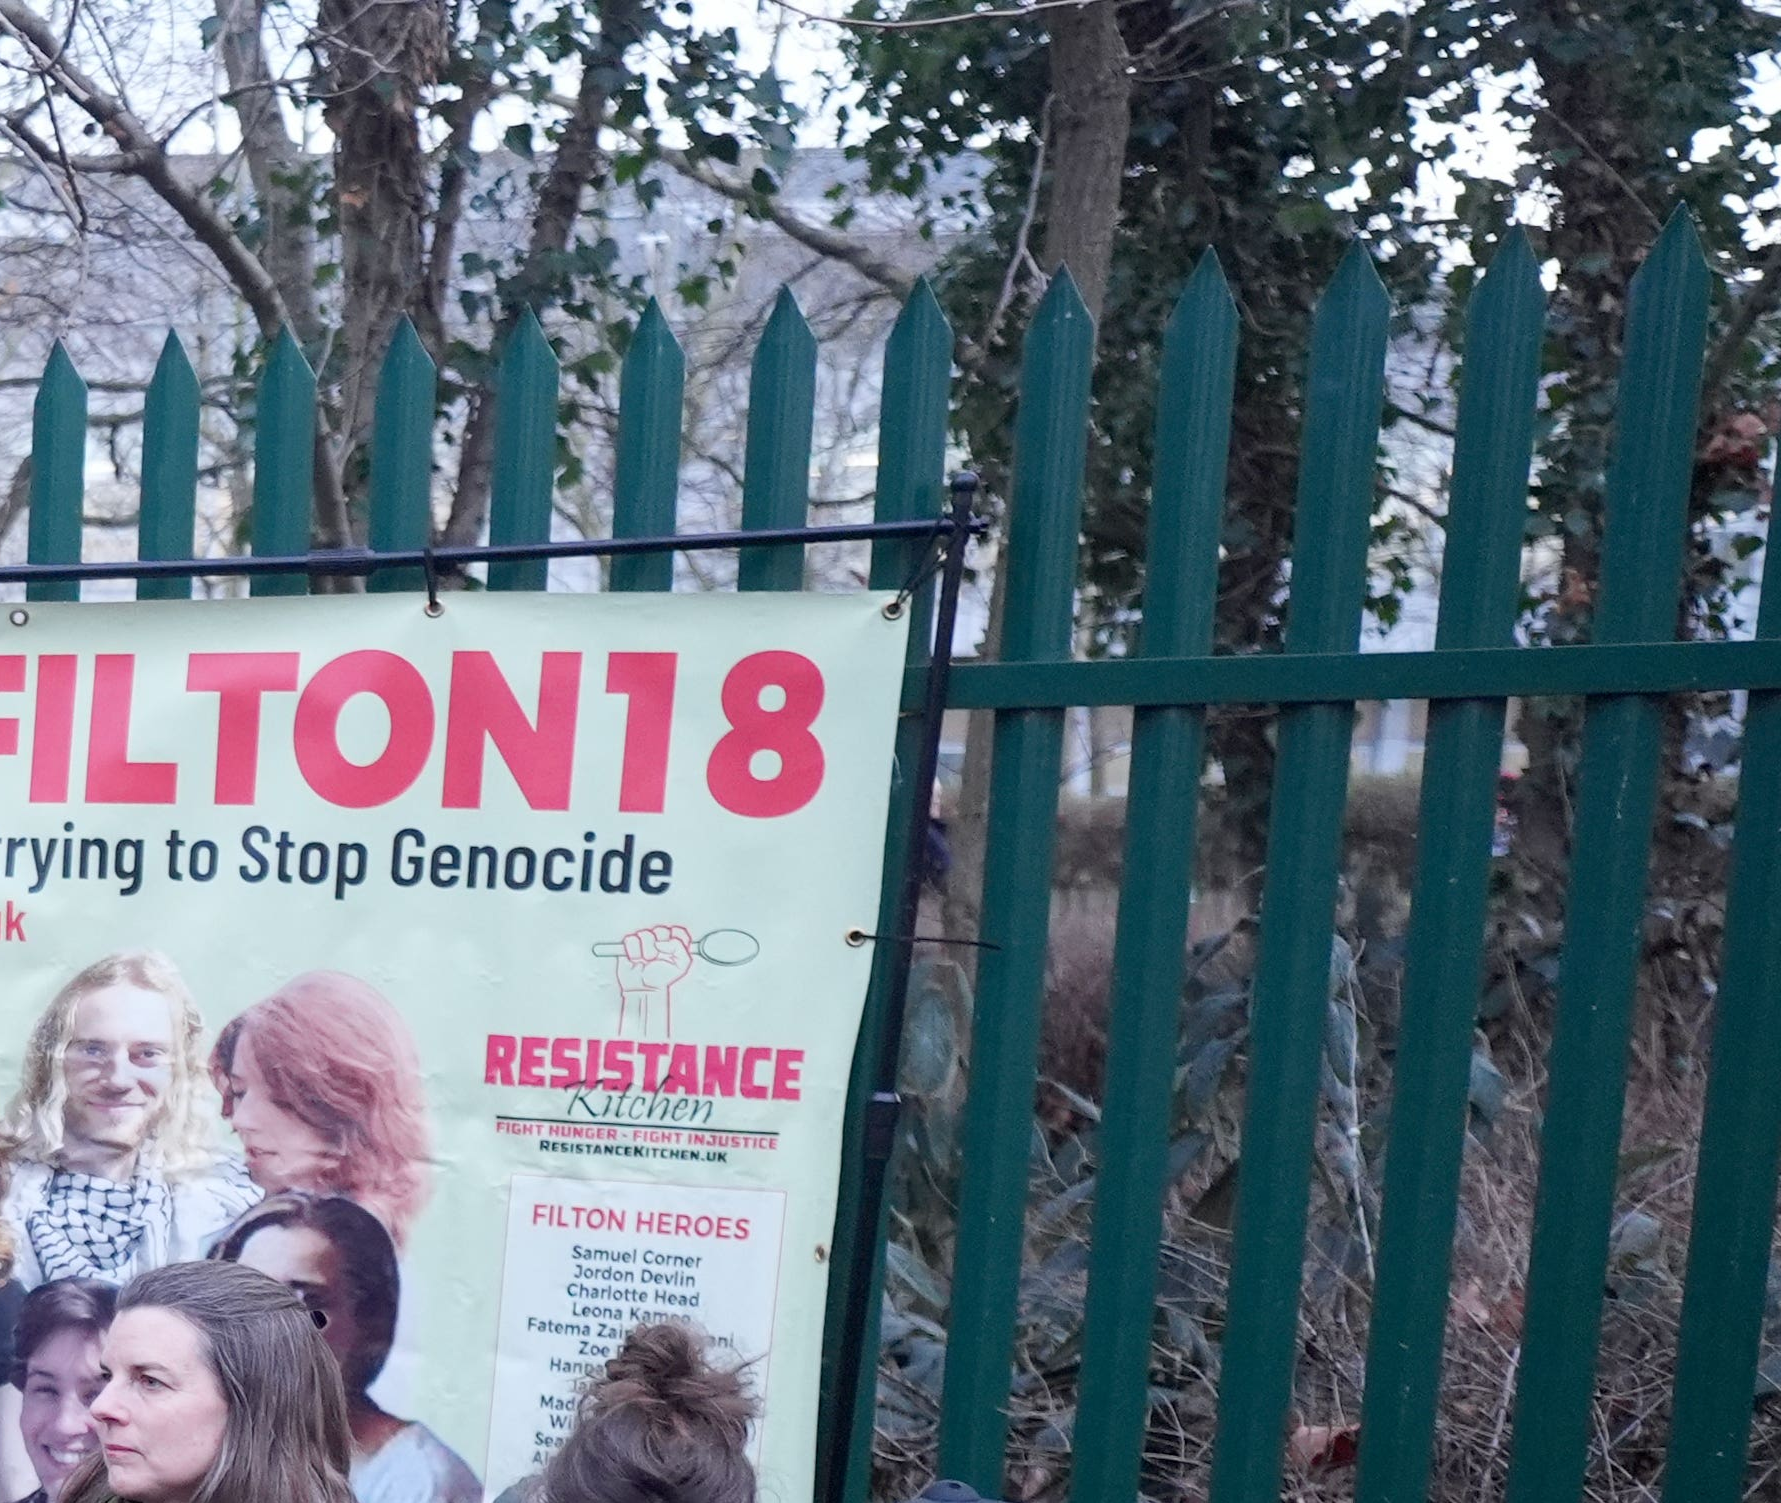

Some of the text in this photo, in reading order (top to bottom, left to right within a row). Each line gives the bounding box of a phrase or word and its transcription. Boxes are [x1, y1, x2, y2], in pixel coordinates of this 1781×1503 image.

[165, 829, 219, 881] to
[239, 825, 368, 899] Stop
[390, 828, 674, 895] Genocide
[484, 1034, 805, 1101] RESISTANCE
[564, 1075, 715, 1125] Kitchen
[496, 1121, 543, 1136] FIGHT
[548, 1125, 617, 1141] HUNGER
[633, 1129, 682, 1145] FIGHT
[687, 1133, 778, 1150] INJUSTICE
[532, 1204, 751, 1240] FILTON HEROES
[571, 1245, 703, 1269] Samuel Corner
[573, 1265, 696, 1287] Jordon Devlin
[567, 1283, 700, 1308] Charlotte Head
[572, 1302, 623, 1321] Leona
[527, 1317, 591, 1337] Fatema
[579, 1341, 610, 1357] Zoe
